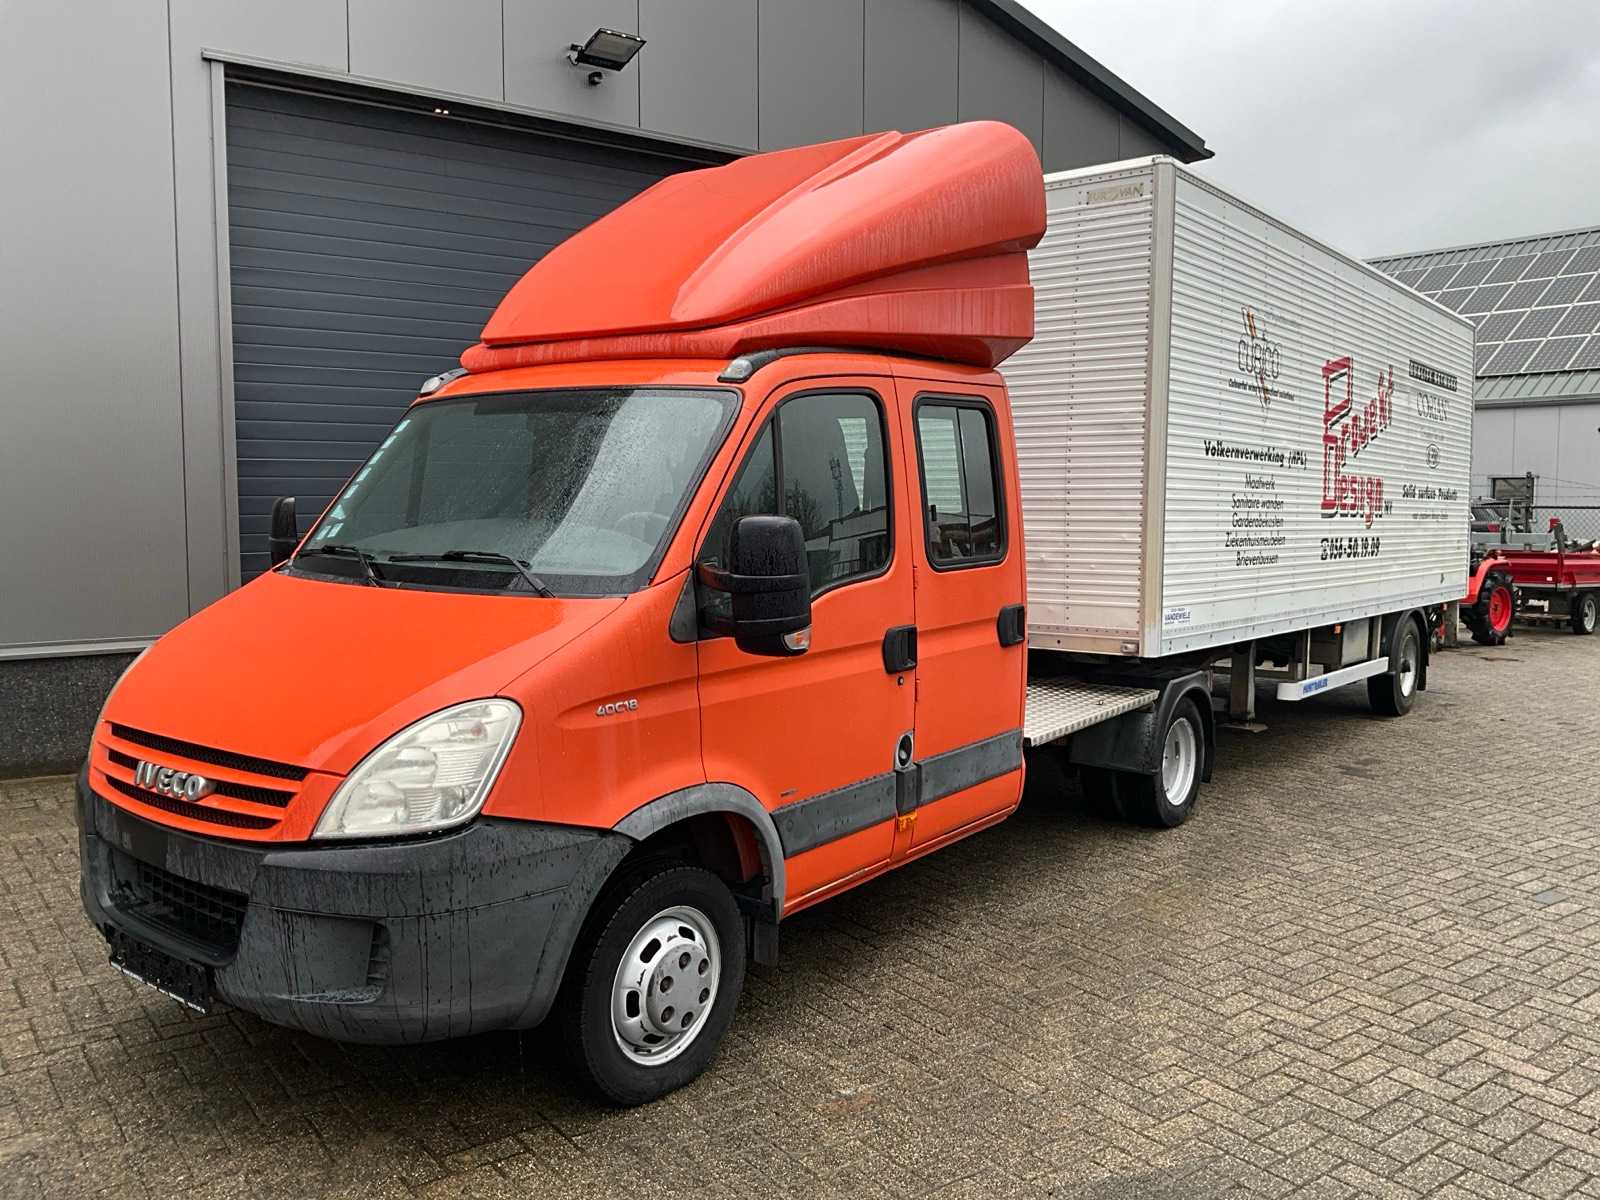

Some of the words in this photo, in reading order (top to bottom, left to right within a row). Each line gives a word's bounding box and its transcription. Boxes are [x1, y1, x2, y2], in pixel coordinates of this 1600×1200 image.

[1203, 439, 1285, 467] Volkernverwerking
[1245, 472, 1276, 490] Maatwerk
[1231, 493, 1260, 509] Sanitaire
[1261, 493, 1284, 510] wanden
[1225, 530, 1286, 547] Ziekenhuismeubelen
[1236, 550, 1279, 567] Brievenbussen
[596, 698, 638, 716] 40C18
[135, 760, 208, 802] IVECO
